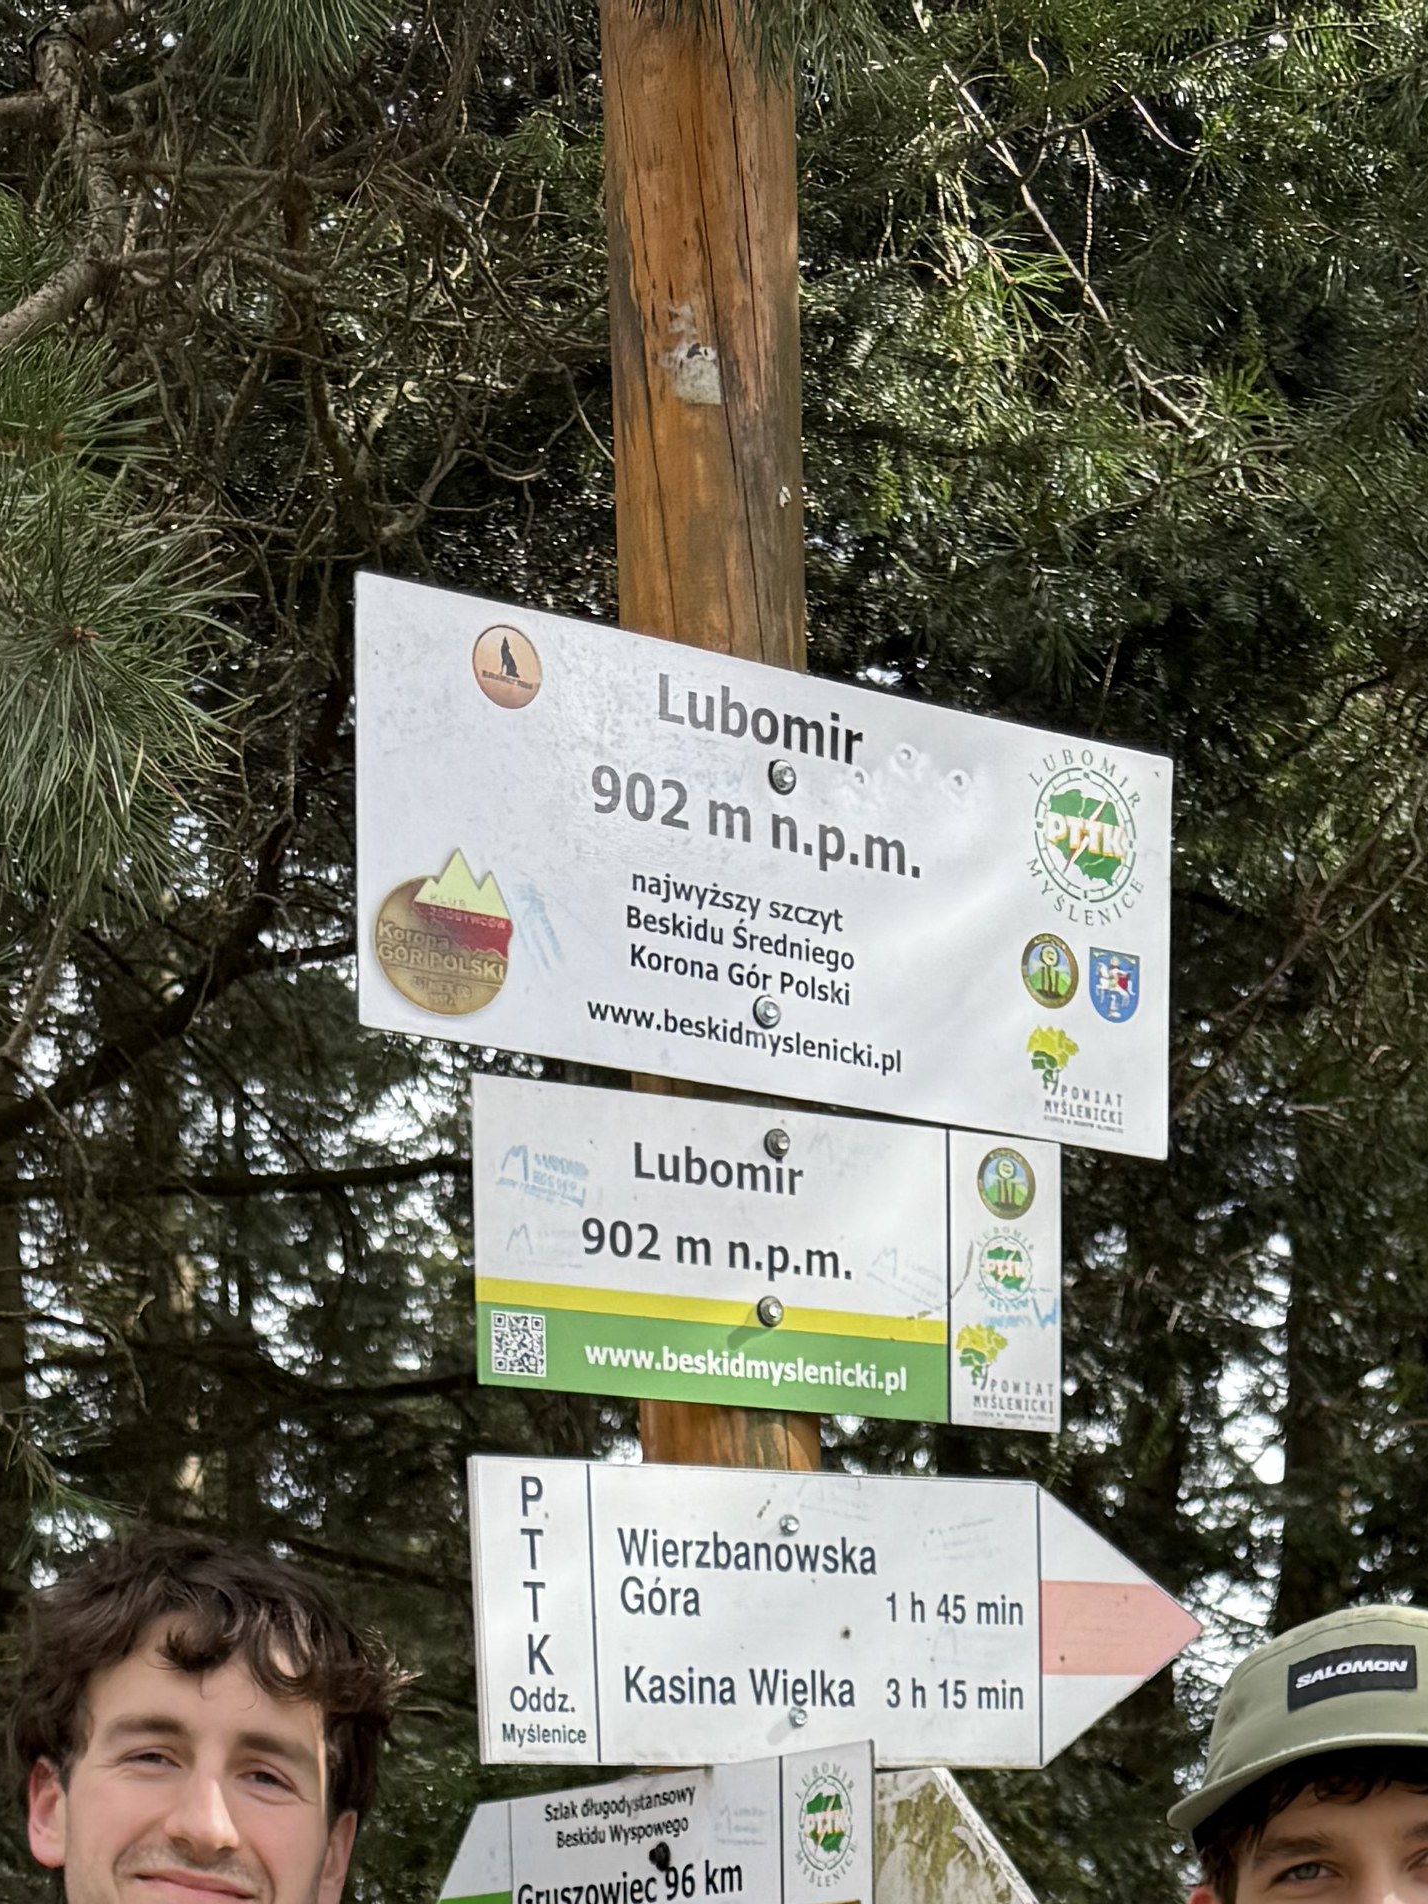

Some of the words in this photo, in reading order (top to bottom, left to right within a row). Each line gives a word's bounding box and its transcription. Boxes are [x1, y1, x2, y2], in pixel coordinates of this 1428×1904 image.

[659, 673, 863, 764] Lubomir
[1029, 749, 1141, 808] LUBOMIR
[591, 764, 689, 830] 902
[708, 800, 751, 843] m
[772, 812, 920, 879] n.p.m.
[1046, 811, 1127, 861] PTTK
[632, 872, 762, 920] najwyższy
[769, 901, 843, 934] szczyt
[626, 905, 724, 946] Beskidu
[732, 918, 855, 972] Średniego
[429, 951, 505, 980] POLSKI
[630, 943, 719, 982] Korona
[727, 962, 772, 992] Gór
[780, 971, 851, 1006] Polski
[587, 1000, 902, 1077] www.beskidmyslenicki.pl
[1060, 1083, 1123, 1108] POWIAT
[633, 1141, 804, 1196] Lubomir
[581, 1217, 661, 1261] 902
[676, 1235, 712, 1266] m
[728, 1240, 852, 1282] n.p.m.
[584, 1343, 908, 1394] www.beskidmyslenicki.pl
[617, 1527, 878, 1575] Wierzbanowska
[620, 1575, 702, 1617] Góra
[886, 1591, 897, 1623] 1
[911, 1591, 925, 1624] h
[936, 1593, 966, 1625] 45
[977, 1593, 1024, 1626] min
[623, 1665, 737, 1706] Kasina
[749, 1667, 856, 1708] Wielka
[886, 1677, 901, 1709] 3
[912, 1677, 926, 1709] h
[938, 1678, 967, 1710] 15
[977, 1679, 1024, 1711] min
[1295, 1658, 1409, 1689] SALOMON
[509, 1685, 576, 1713] Oddz.
[501, 1722, 587, 1748] Myślenice
[544, 1800, 579, 1823] Szlak
[581, 1785, 696, 1819] długodystansowy
[556, 1825, 606, 1849] Beskidu
[608, 1816, 689, 1846] Wyspowego
[665, 1862, 696, 1901] 96
[705, 1859, 743, 1896] km
